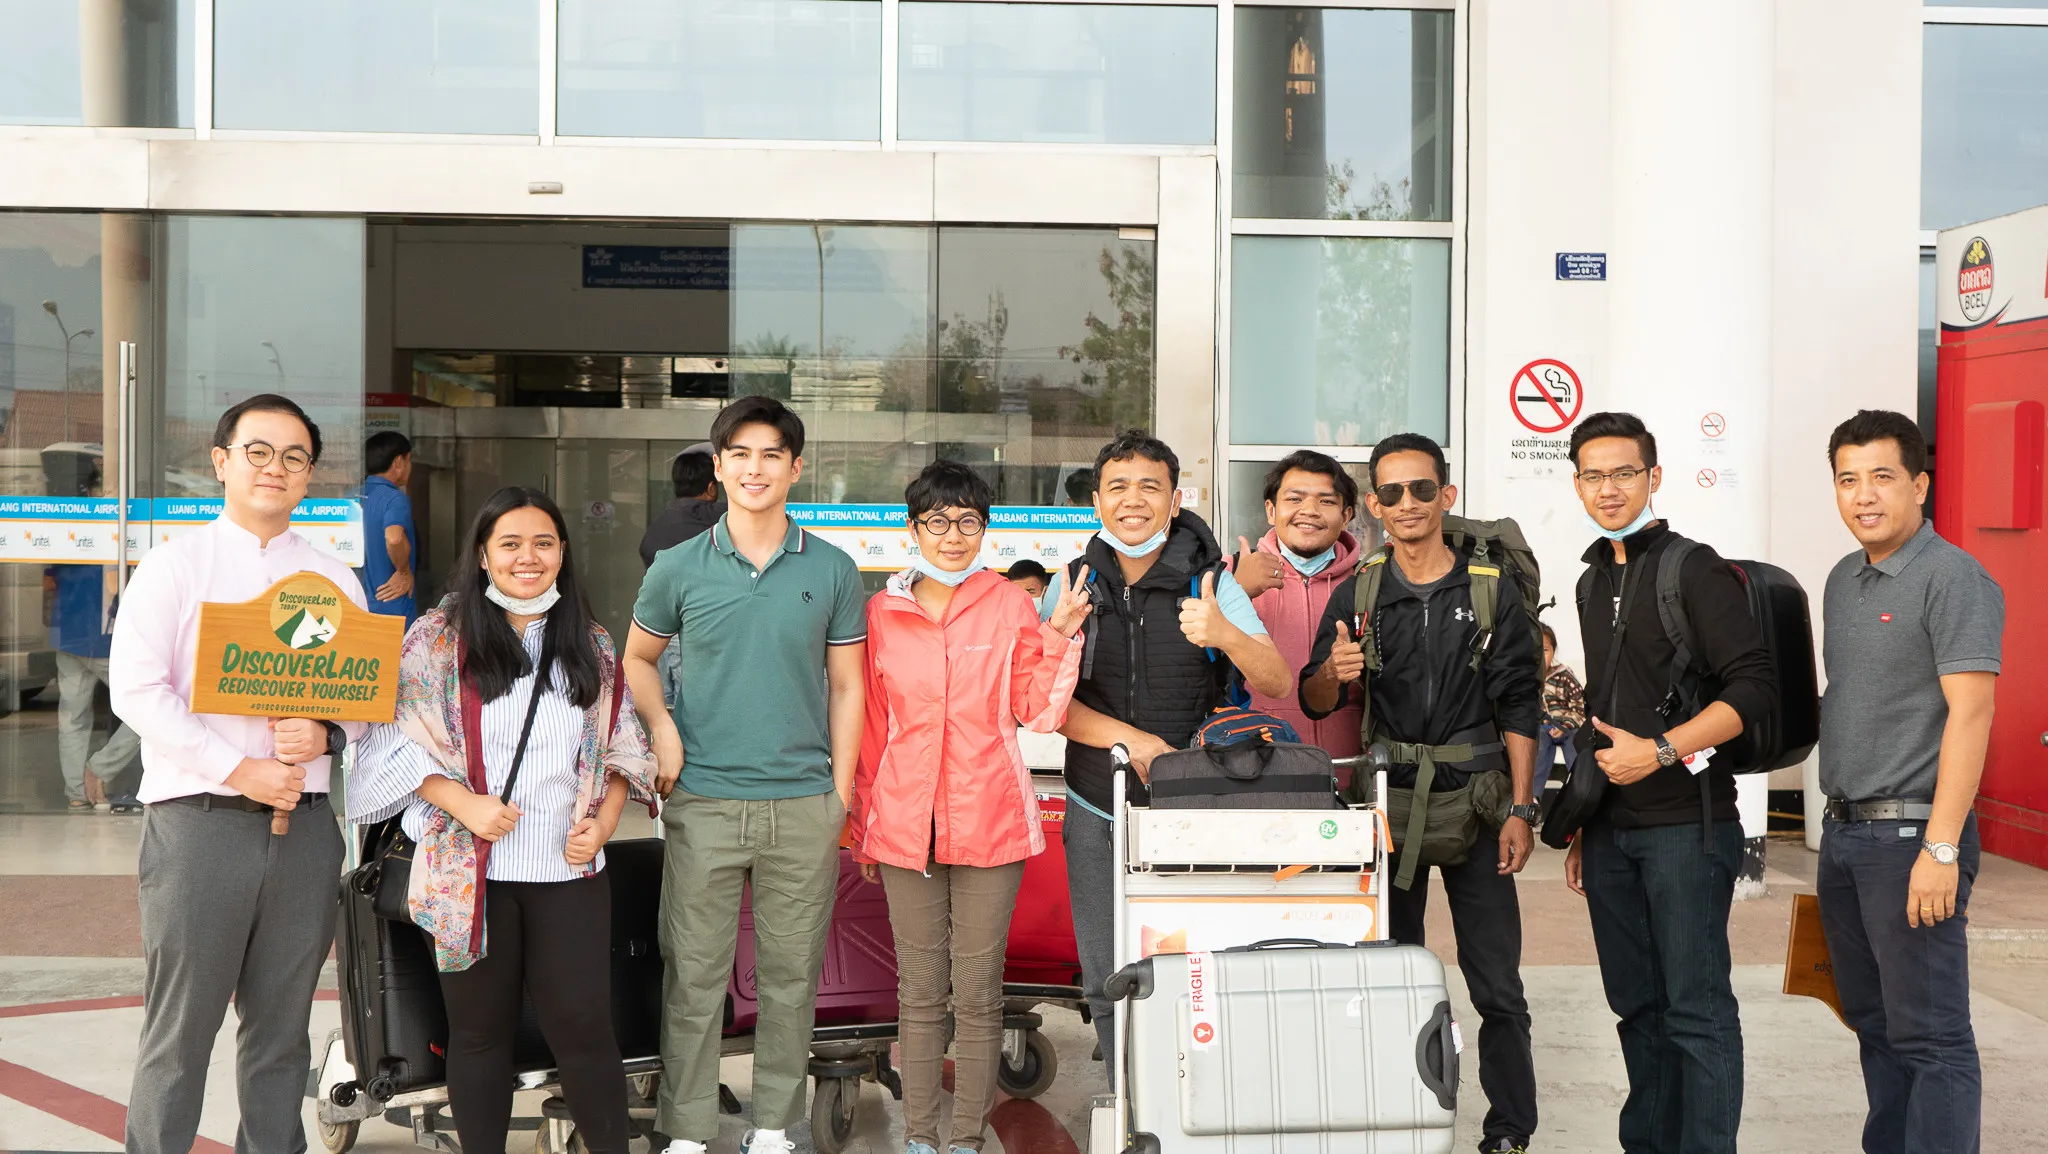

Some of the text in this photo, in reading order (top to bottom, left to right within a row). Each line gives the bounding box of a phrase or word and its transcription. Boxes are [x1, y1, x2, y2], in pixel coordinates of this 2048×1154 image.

[1965, 293, 1986, 310] BCEL
[1511, 451, 1570, 460] NO SMOKIN
[22, 502, 91, 514] INTERNATIONAL
[93, 504, 132, 514] AIRPOT
[167, 504, 223, 515] LUANG PRAB
[311, 505, 349, 516] AIRPORT
[816, 510, 881, 521] INTERNATIONAL
[884, 511, 908, 522] AIRPO
[1031, 513, 1097, 524] INTERNATIONAL
[866, 543, 884, 556] unitel
[998, 544, 1016, 556] unitel
[1040, 545, 1058, 557] unitel
[280, 603, 298, 611] TODAY
[221, 642, 380, 682] DISCOVERLAOS
[218, 677, 379, 701] REDISCOVER YOURSELF
[250, 703, 341, 714] #DISCOVERLAOSTODAY
[1189, 957, 1204, 1012] FRAGILE
